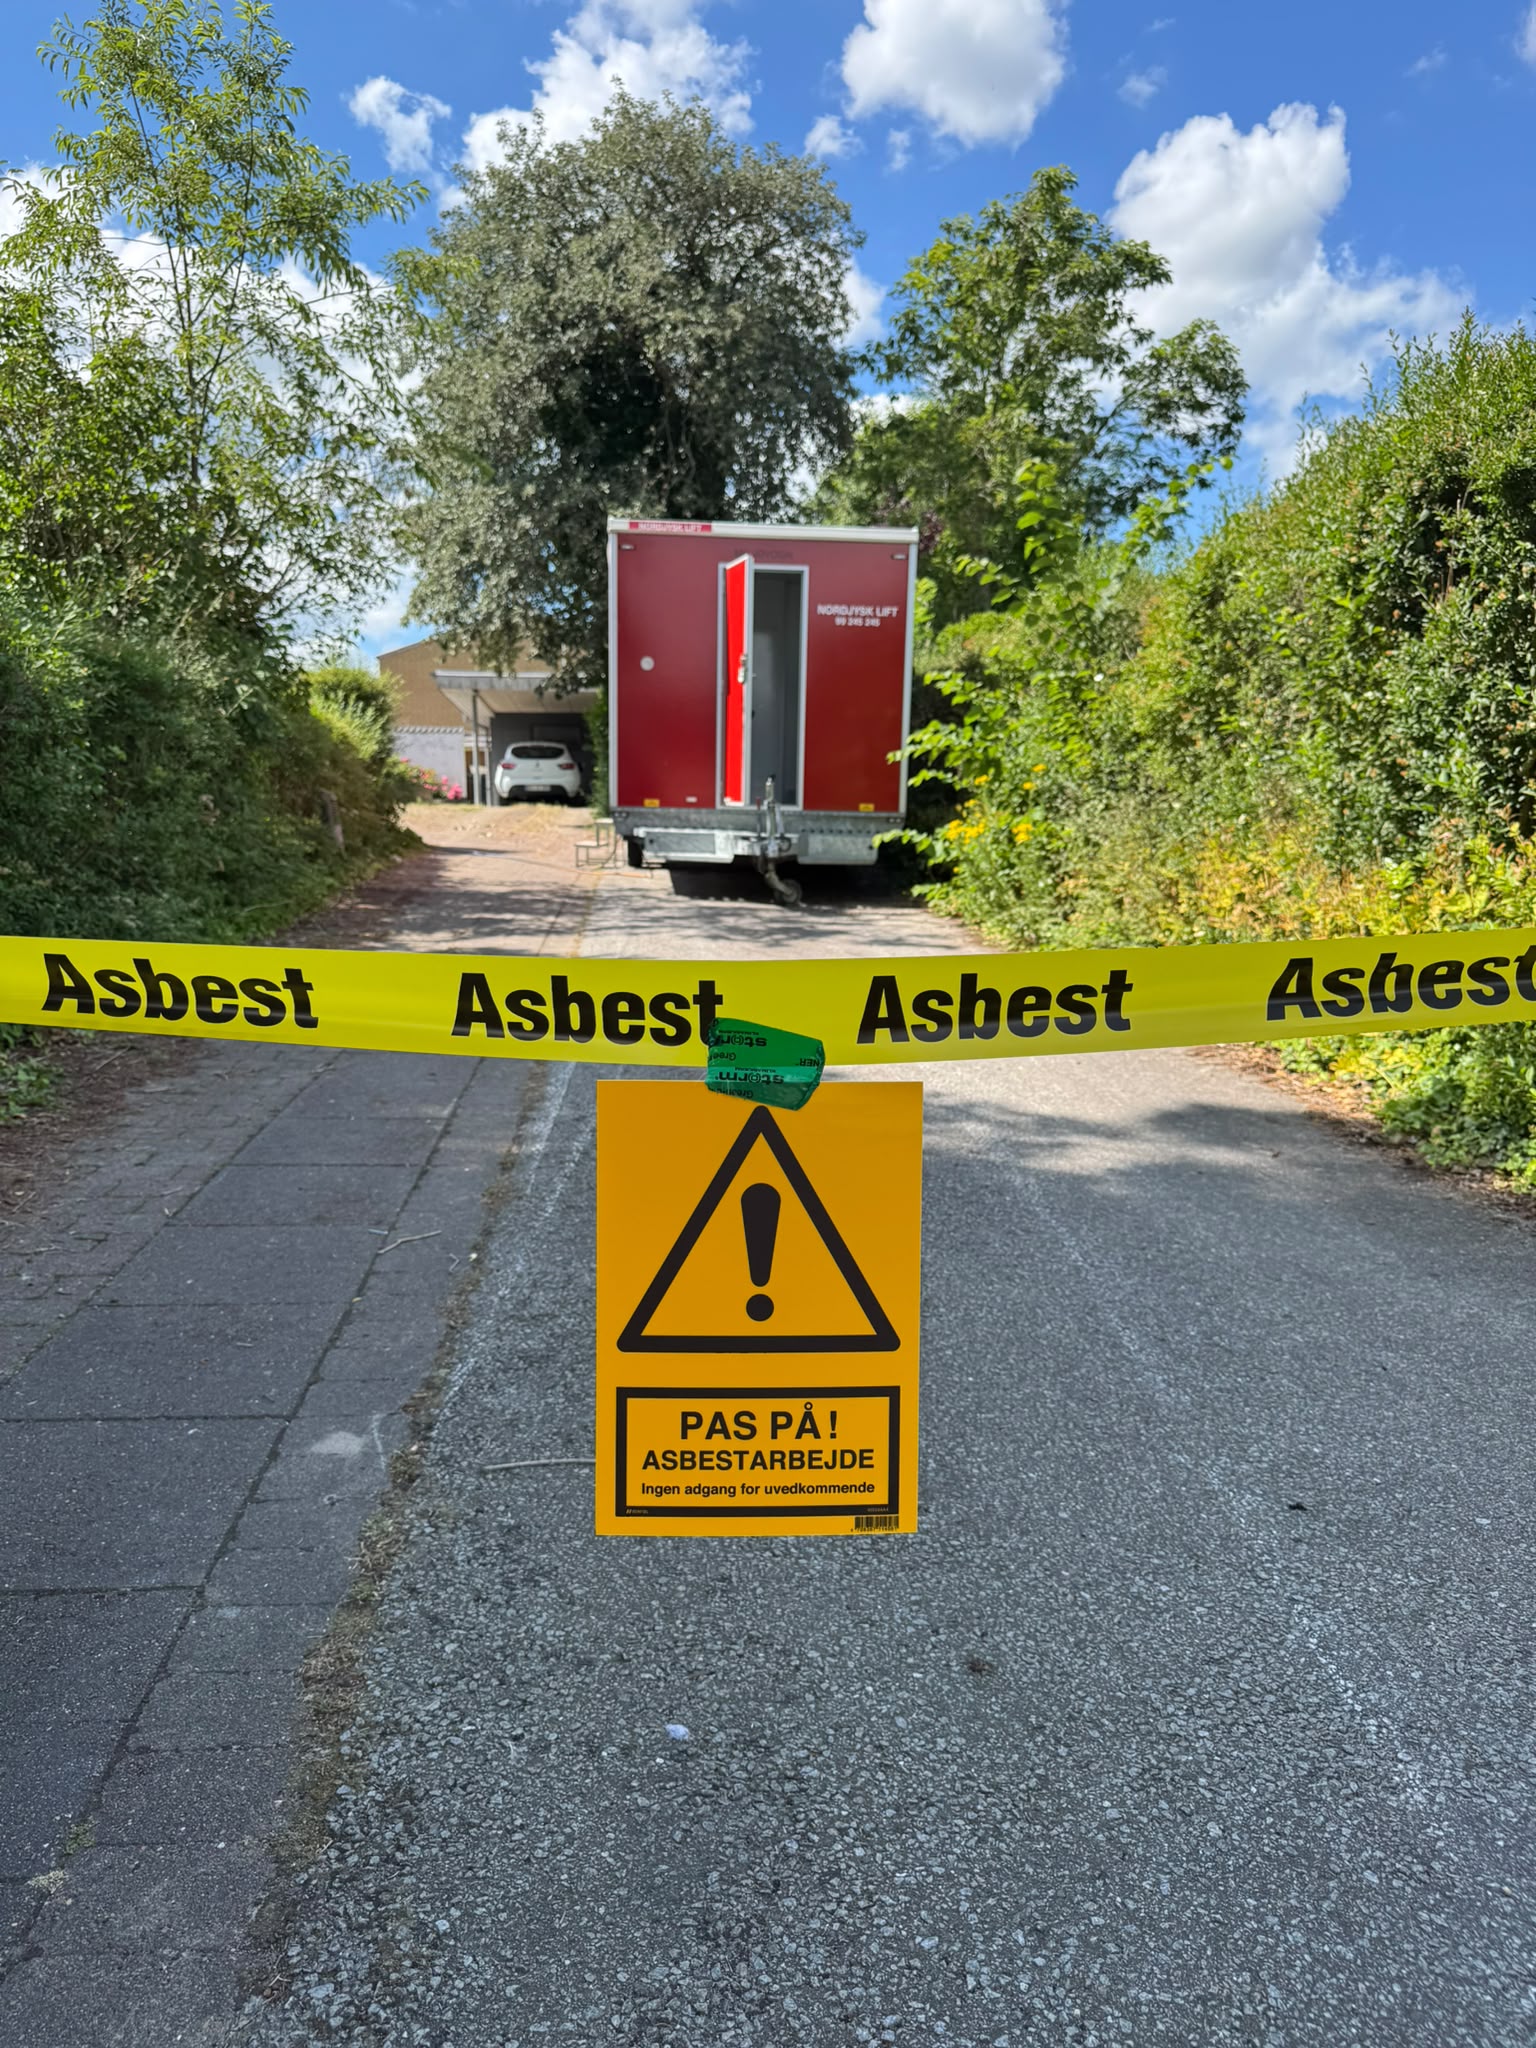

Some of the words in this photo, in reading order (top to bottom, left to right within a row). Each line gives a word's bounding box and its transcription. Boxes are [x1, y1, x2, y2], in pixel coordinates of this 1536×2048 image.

[817, 603, 874, 616] NORDJYSK
[875, 605, 899, 617] LIFT
[40, 953, 319, 1030] Asbest
[451, 971, 723, 1048] Asbest
[856, 969, 1134, 1045] Asbest
[680, 1411, 757, 1440] PAS
[642, 1449, 875, 1471] ASBESTARBEJDE
[641, 1483, 680, 1497] Ingen
[684, 1483, 737, 1497] adgang
[740, 1482, 760, 1495] for
[764, 1482, 875, 1495] uvedkommende
